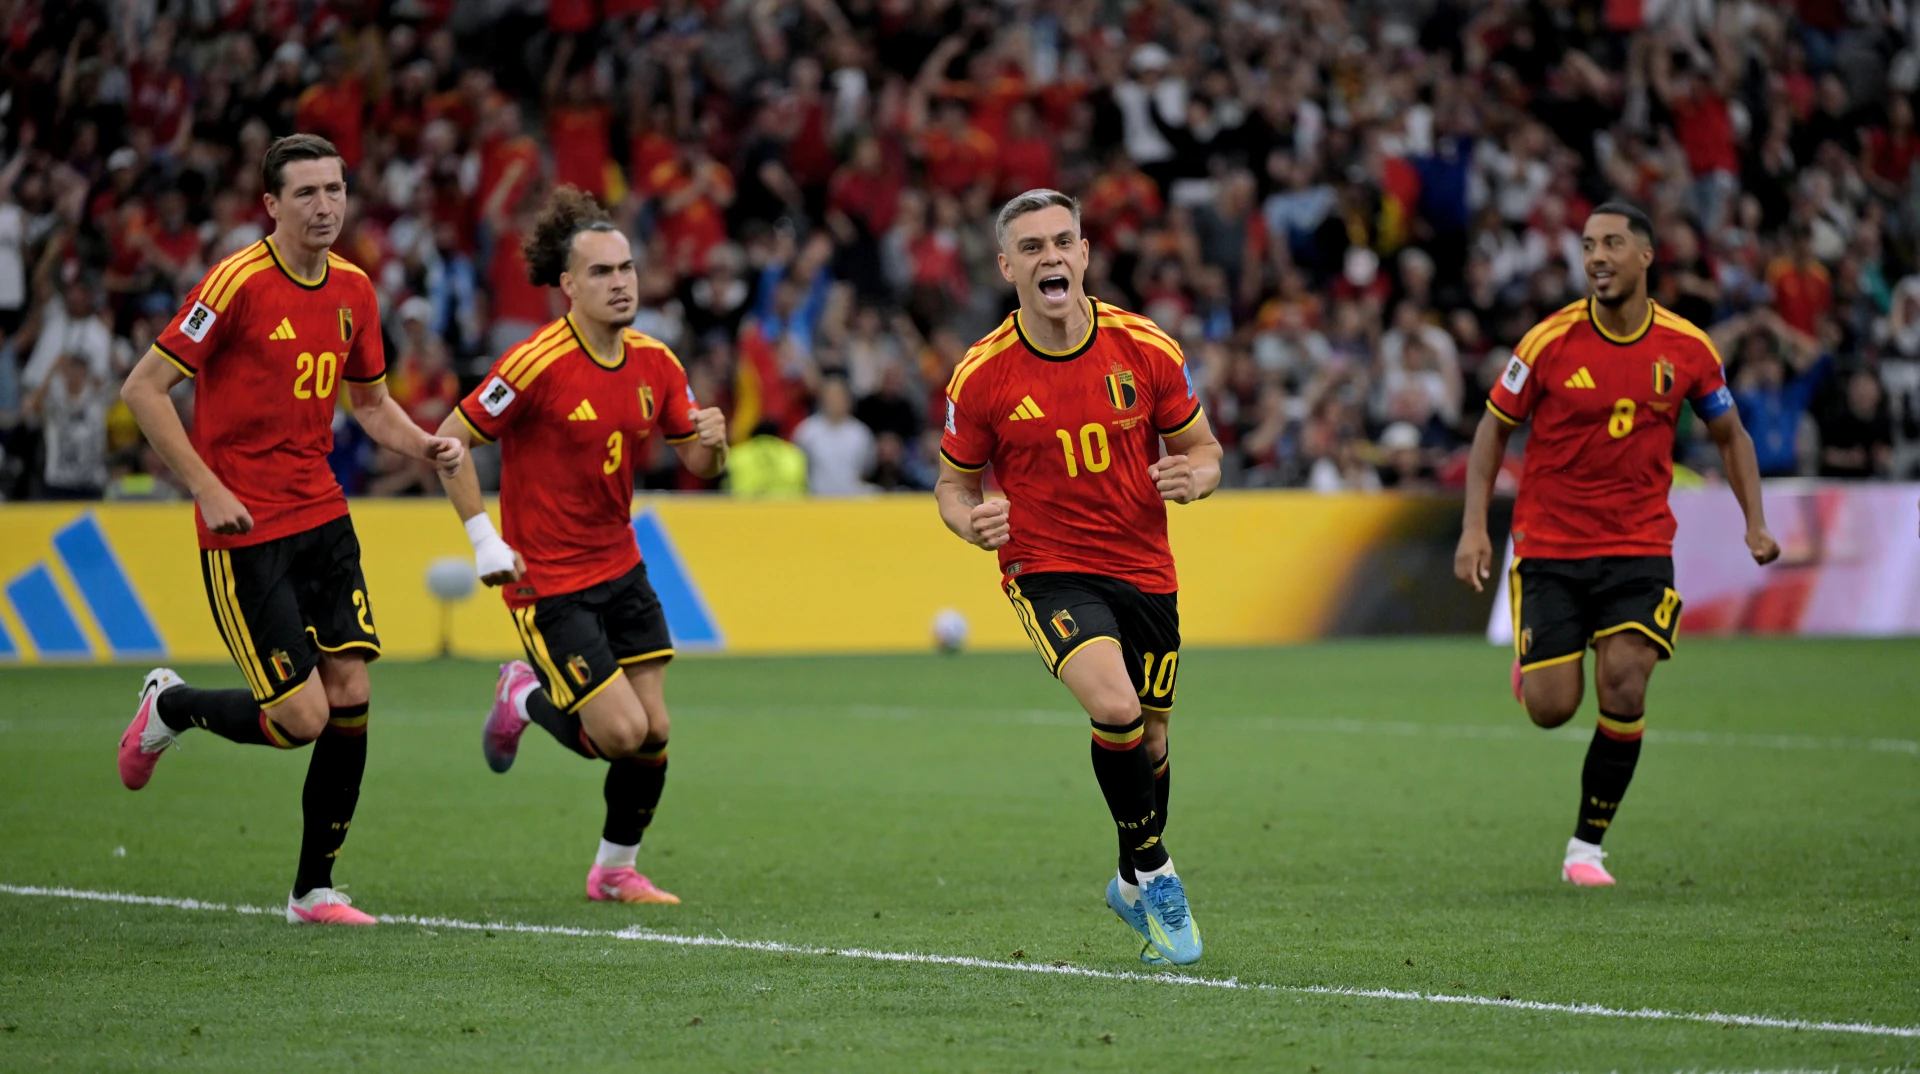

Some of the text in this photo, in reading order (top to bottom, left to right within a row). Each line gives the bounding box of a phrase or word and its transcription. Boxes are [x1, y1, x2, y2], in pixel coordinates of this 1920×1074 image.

[294, 352, 337, 399] 20
[1608, 398, 1636, 439] 8
[603, 431, 623, 475] 3
[1056, 422, 1111, 478] 10
[1654, 587, 1680, 630] 8
[1138, 651, 1178, 698] 10
